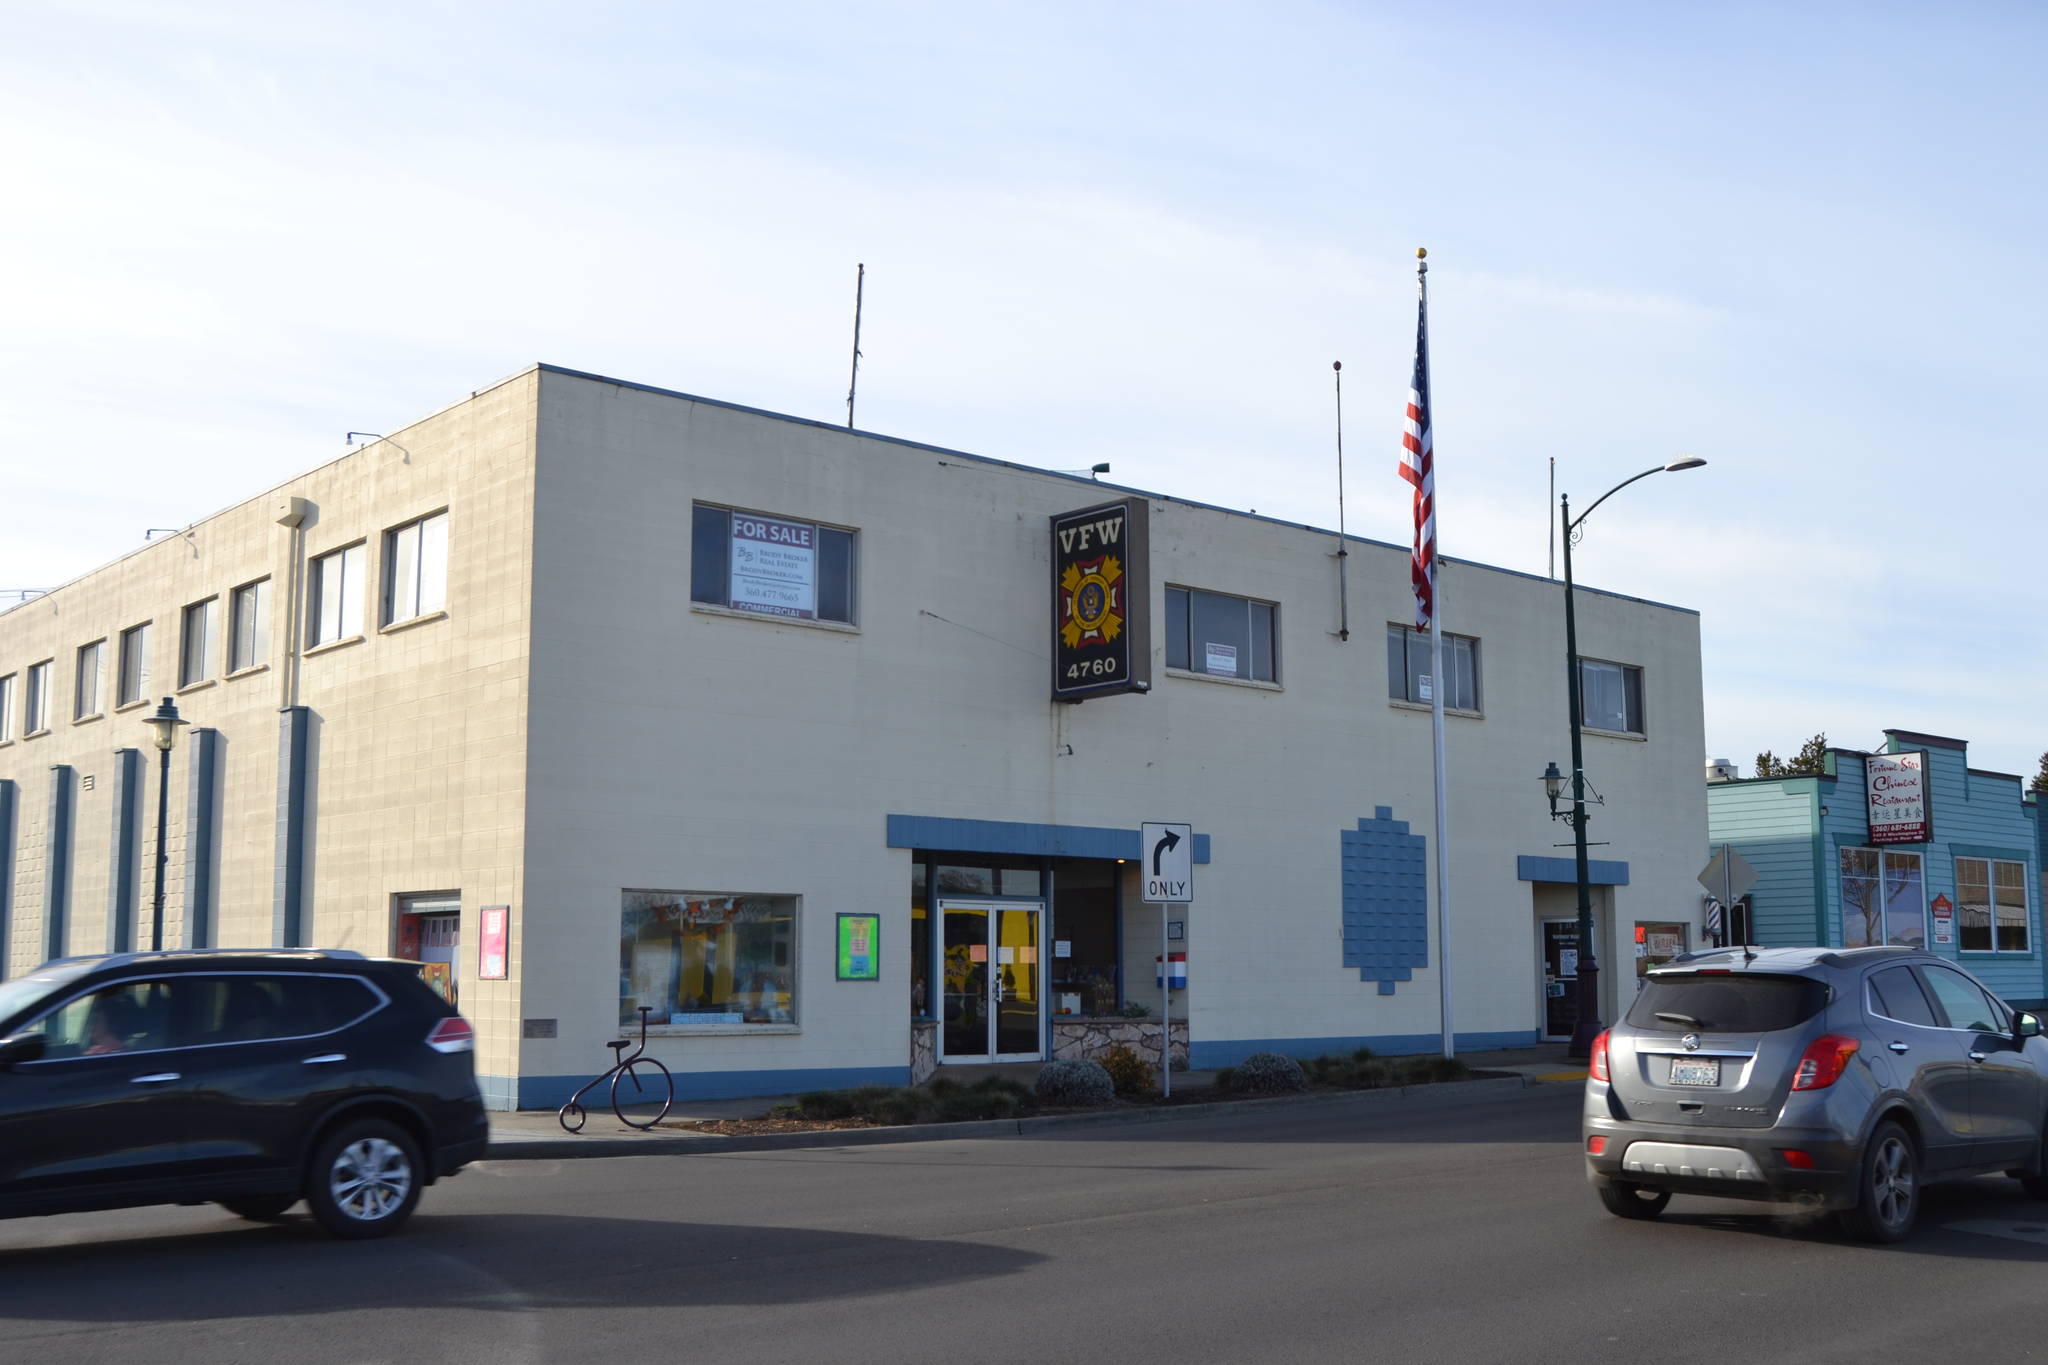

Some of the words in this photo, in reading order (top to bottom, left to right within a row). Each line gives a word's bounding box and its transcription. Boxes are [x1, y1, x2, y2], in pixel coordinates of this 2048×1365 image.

[733, 520, 766, 539] FOR
[770, 526, 809, 545] SALE
[1059, 517, 1123, 554] VFW
[1067, 657, 1116, 679] 4760
[1868, 760, 1898, 773] Fortune
[1900, 757, 1919, 772] Star
[1873, 775, 1917, 791] Chinese
[1871, 794, 1920, 807] Restaurant
[1149, 880, 1185, 896] ONLY
